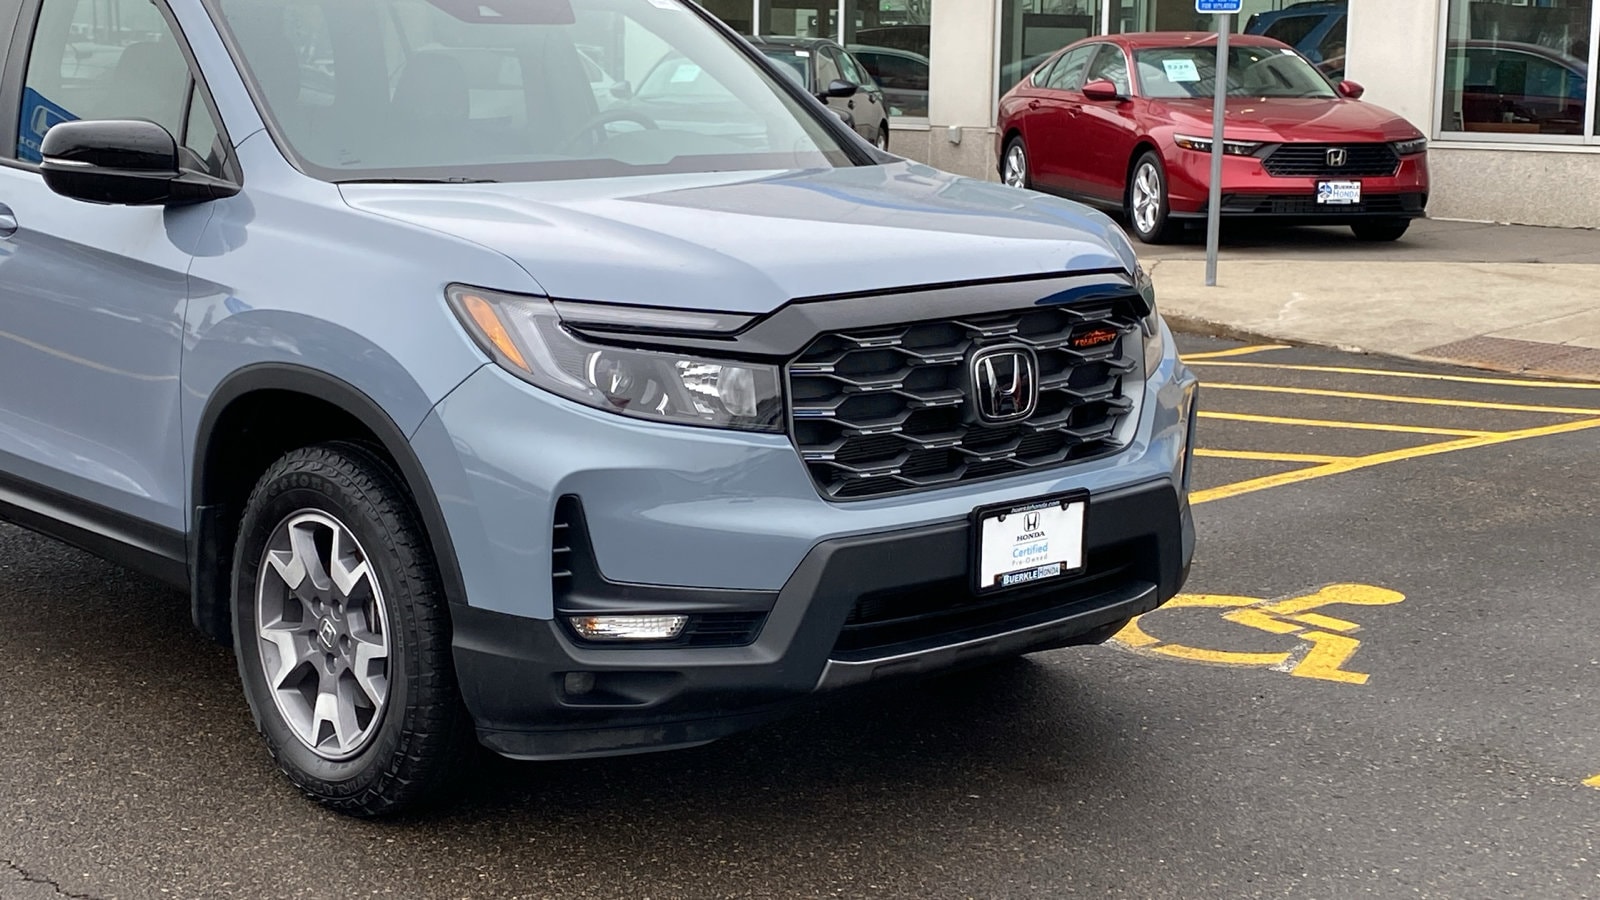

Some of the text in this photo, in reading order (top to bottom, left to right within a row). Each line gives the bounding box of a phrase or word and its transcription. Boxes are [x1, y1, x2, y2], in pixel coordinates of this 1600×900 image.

[1333, 190, 1359, 198] HONDA
[1016, 531, 1045, 541] HONDA
[1012, 541, 1048, 558] Certified
[1011, 553, 1048, 567] Pre-Owned
[1003, 570, 1038, 585] BUERKLE
